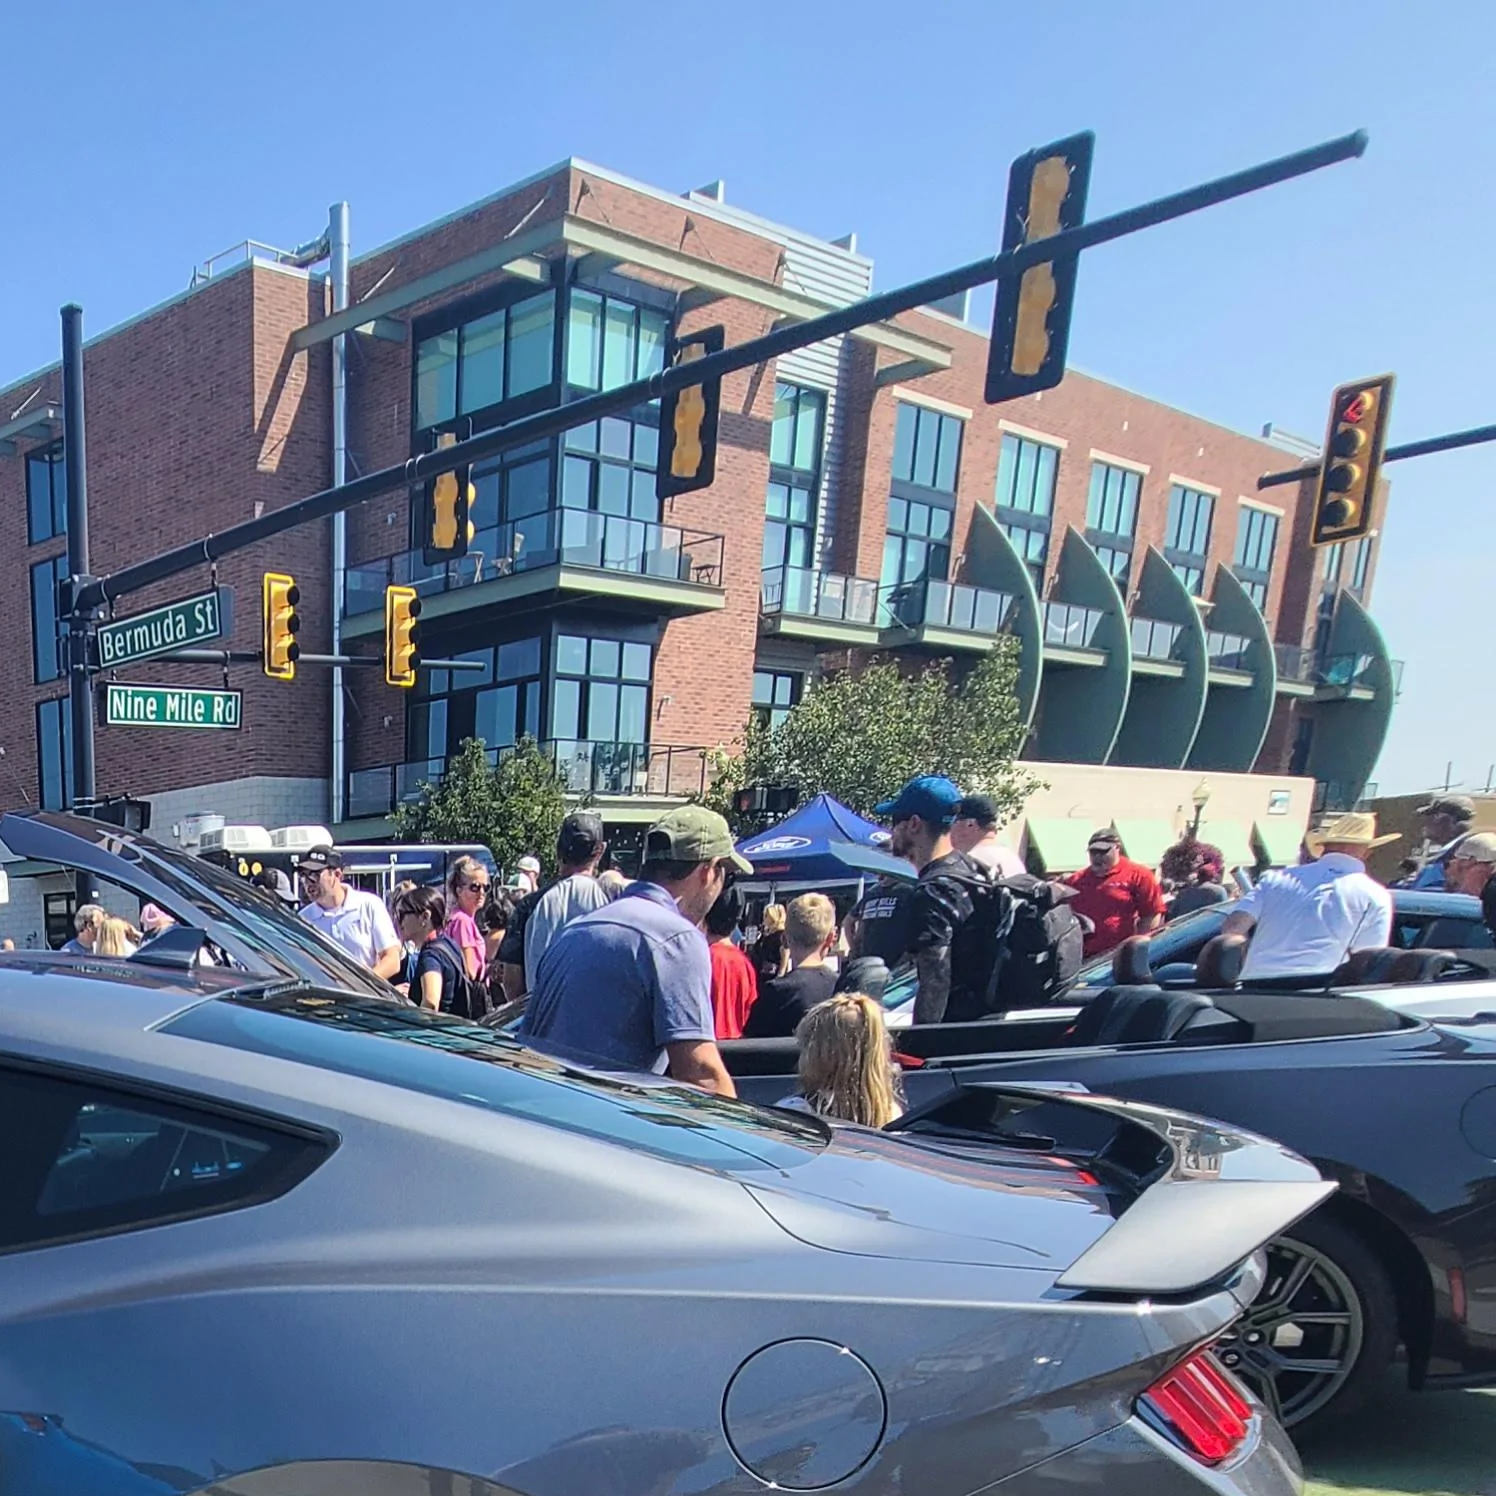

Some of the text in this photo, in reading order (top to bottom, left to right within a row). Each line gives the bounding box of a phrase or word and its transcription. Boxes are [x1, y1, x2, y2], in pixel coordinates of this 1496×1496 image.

[102, 601, 215, 661] Bermuda St
[112, 691, 236, 723] Nine Mile Rd
